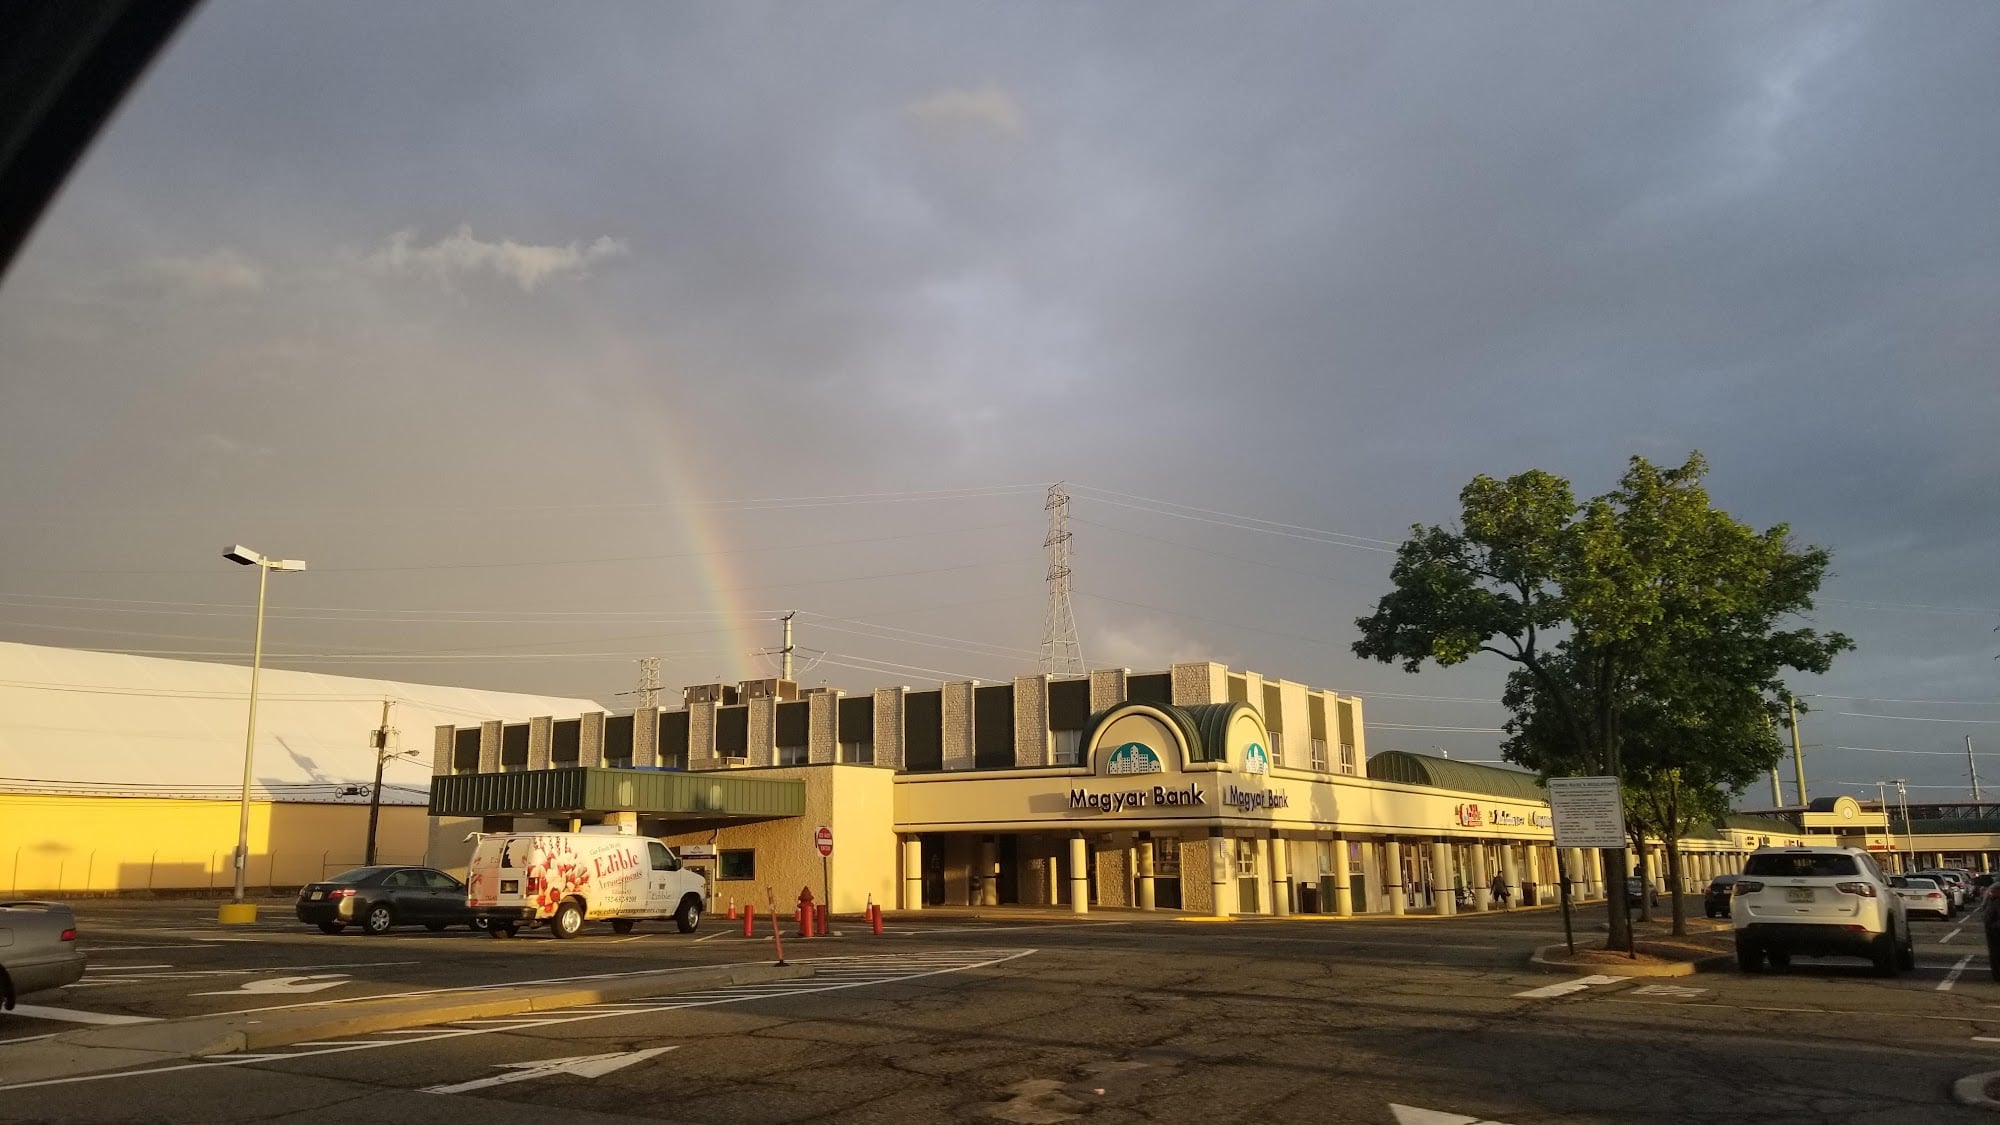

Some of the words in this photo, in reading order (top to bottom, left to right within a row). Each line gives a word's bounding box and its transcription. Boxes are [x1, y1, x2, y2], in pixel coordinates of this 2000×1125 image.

[1069, 788, 1147, 813] Magyar
[1153, 782, 1206, 805] Bank
[1229, 785, 1264, 812] Magyar
[1268, 787, 1289, 808] Bank
[594, 848, 640, 878] Edible
